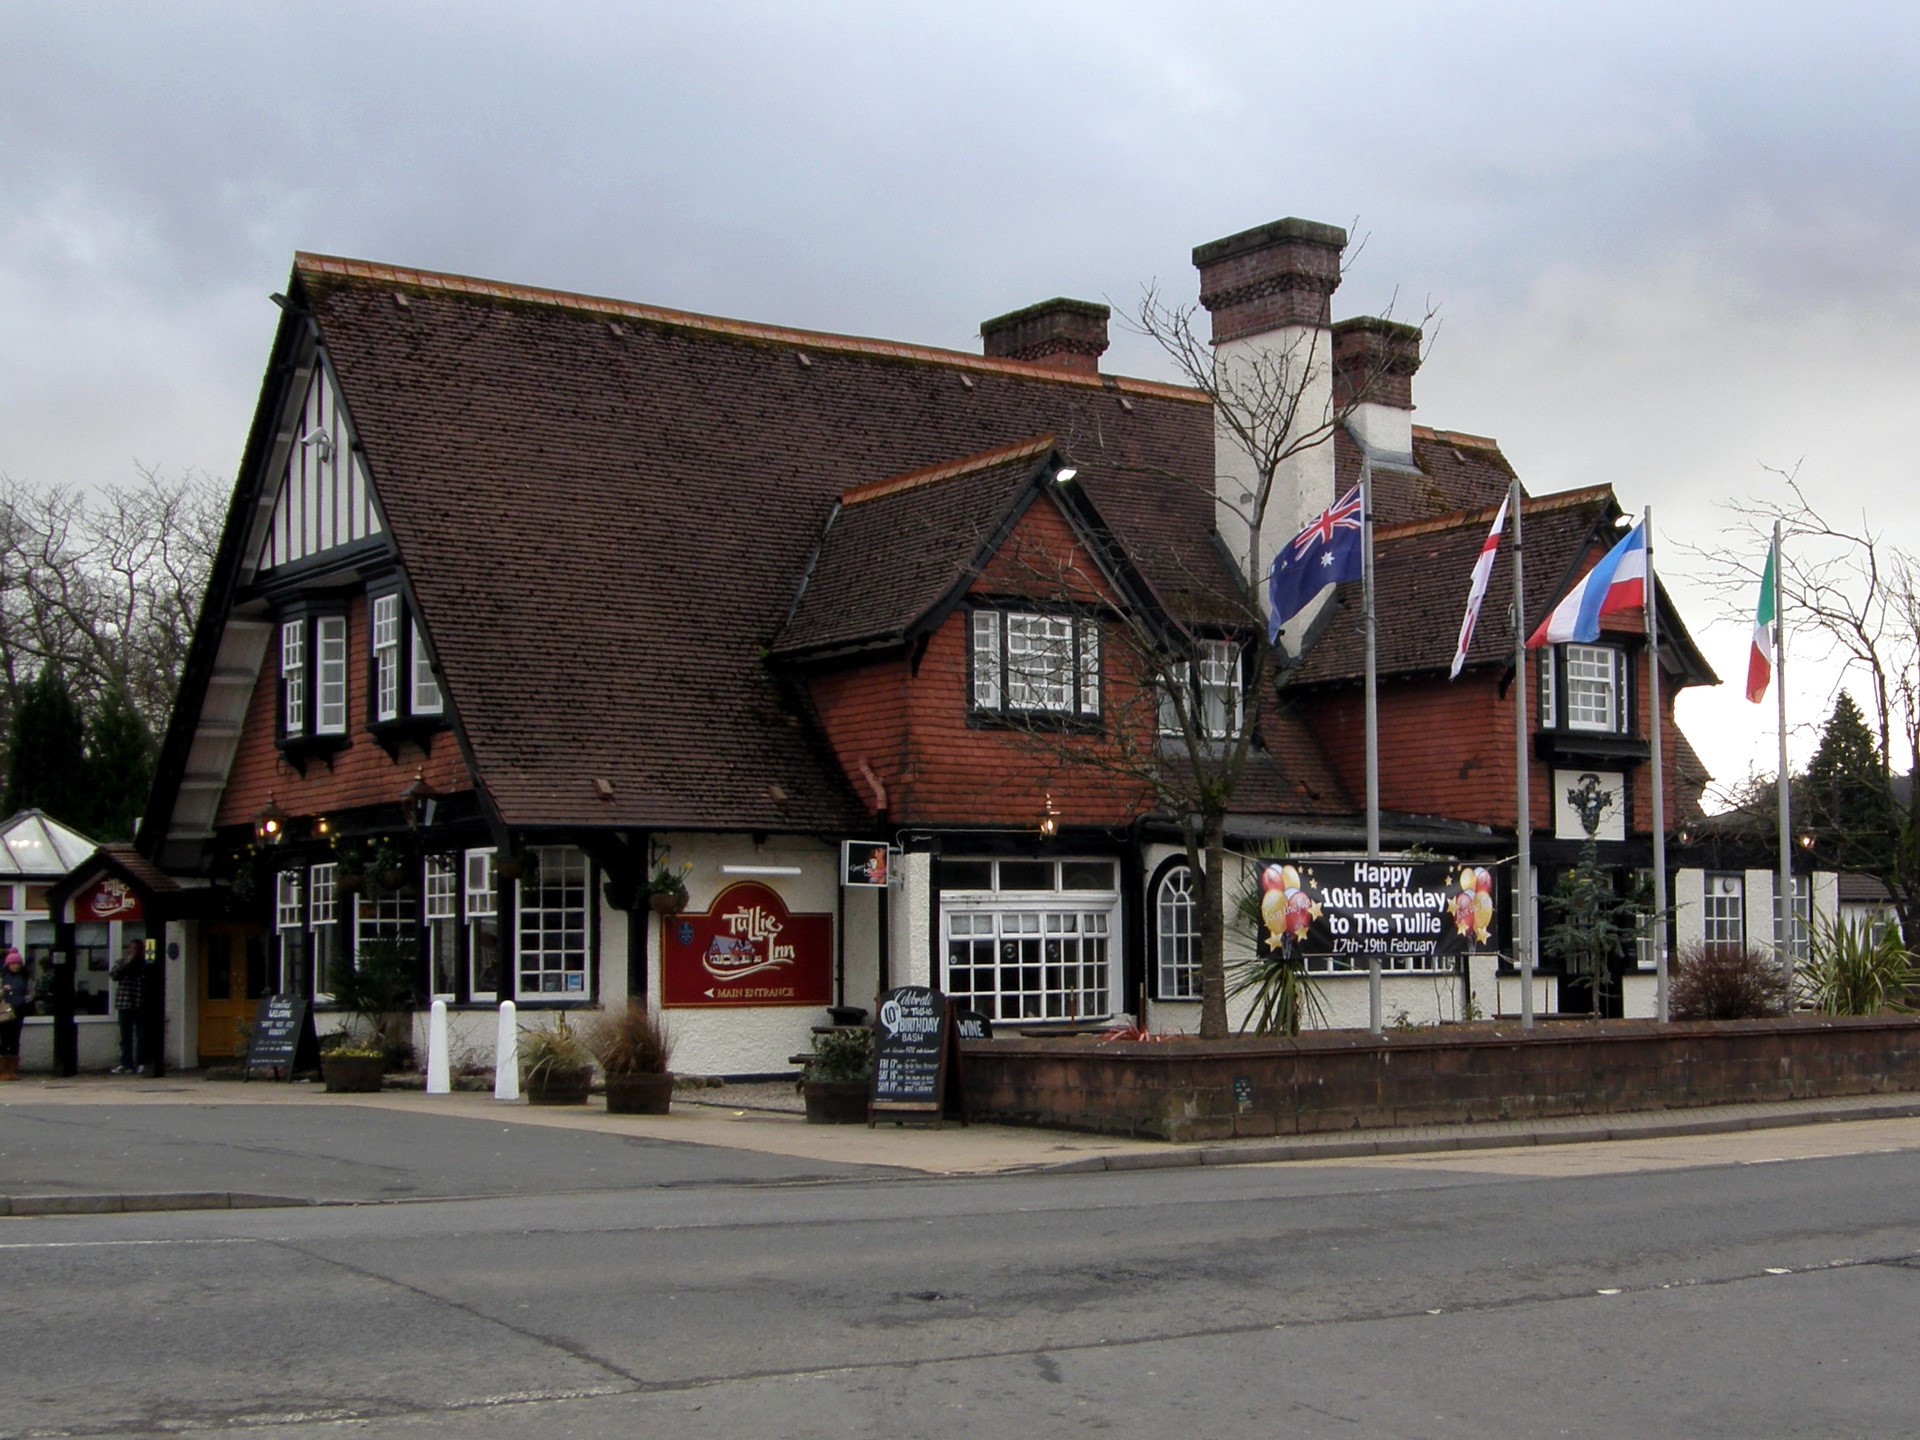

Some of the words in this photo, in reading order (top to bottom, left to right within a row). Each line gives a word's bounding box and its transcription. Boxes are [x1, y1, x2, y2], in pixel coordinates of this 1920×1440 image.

[1354, 862, 1412, 888] Happy
[1321, 888, 1363, 908] 10th
[1369, 887, 1446, 913] Birthday
[722, 905, 784, 942] Tullie
[1330, 915, 1349, 934] to
[1353, 913, 1388, 934] The
[1392, 913, 1441, 934] Tullie
[768, 932, 796, 963] Inn
[1332, 938, 1387, 953] 17th-19th
[1390, 938, 1437, 955] February
[717, 988, 743, 998] MAIN
[745, 987, 795, 998] ENTRANCE
[884, 1005, 899, 1024] 10
[899, 1017, 940, 1033] BIRTHDAY
[956, 1020, 984, 1037] WINE
[902, 1033, 924, 1042] BASH
